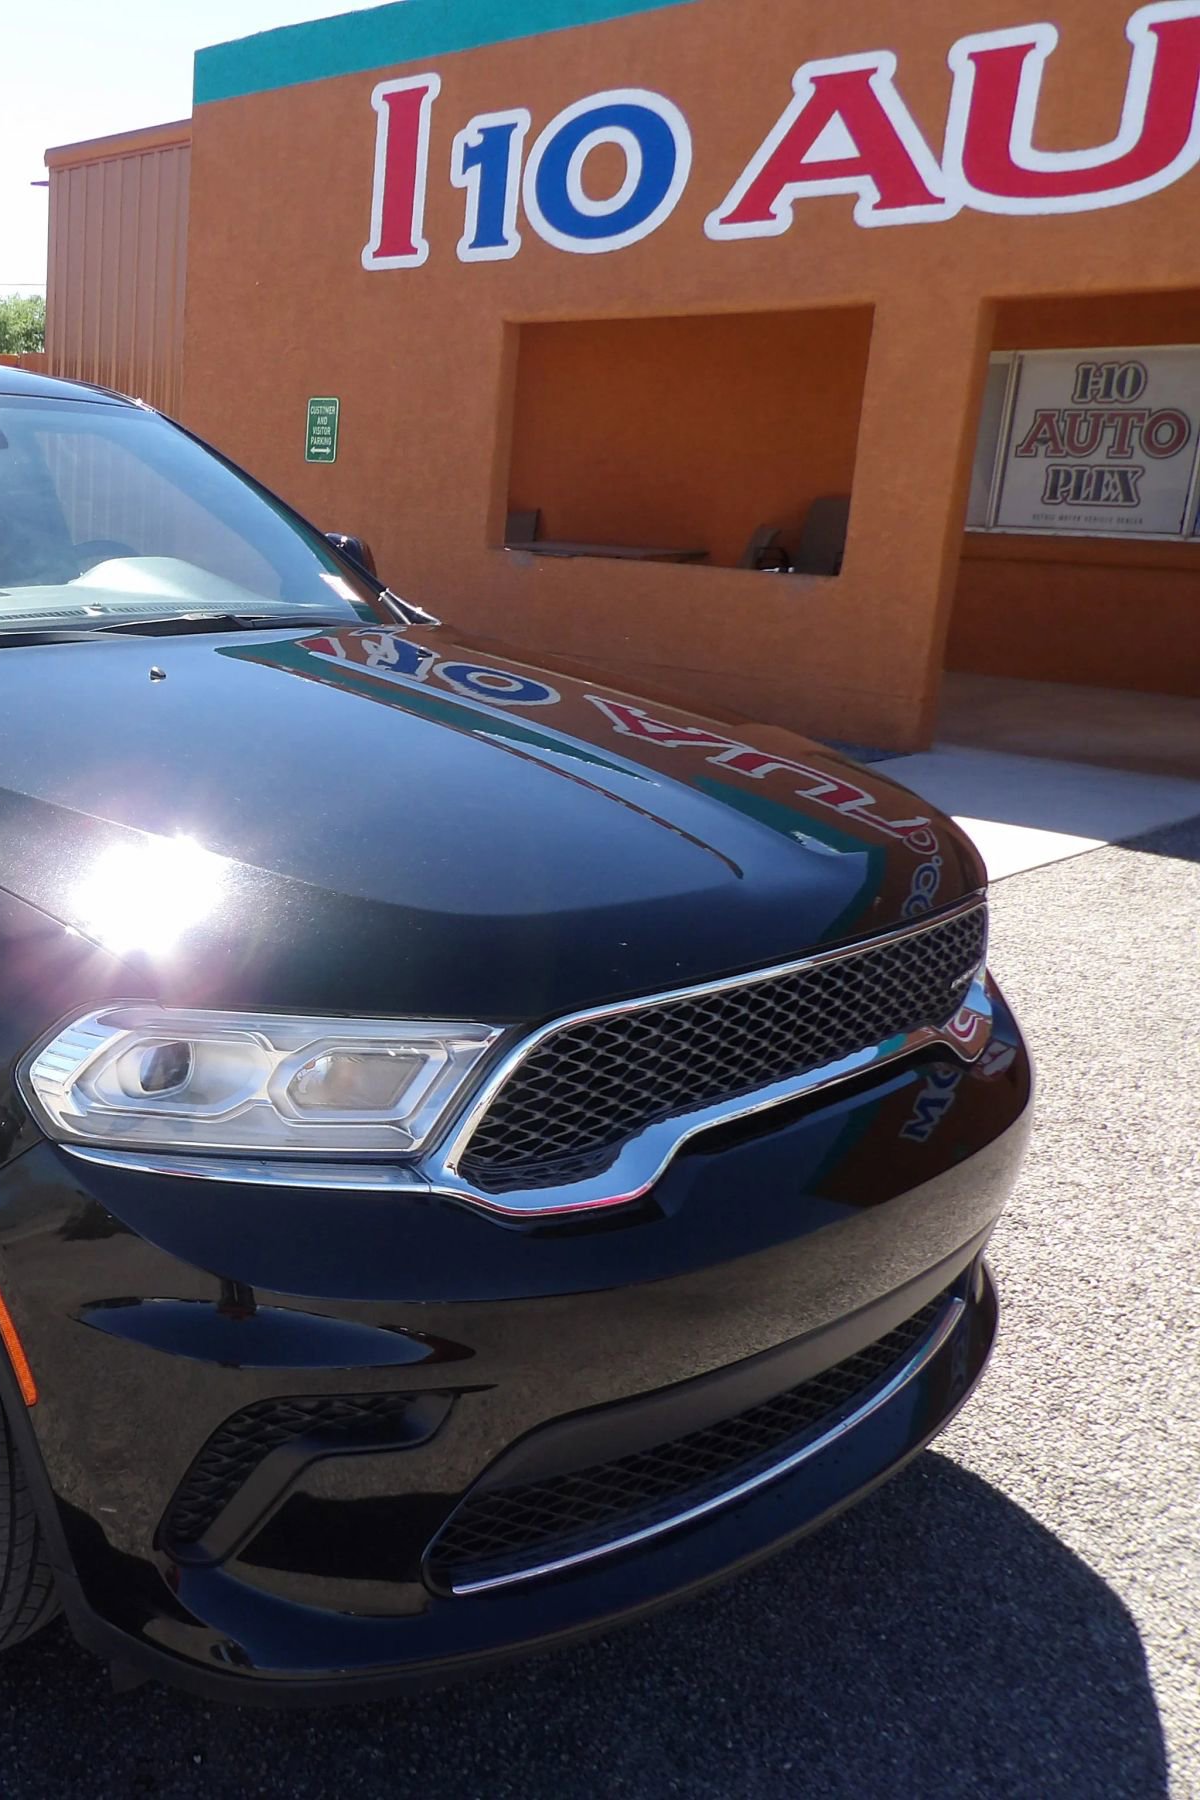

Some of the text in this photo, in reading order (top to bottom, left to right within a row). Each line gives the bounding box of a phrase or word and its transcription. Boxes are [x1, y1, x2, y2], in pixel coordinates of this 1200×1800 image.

[310, 406, 336, 415] CUSTOMER
[316, 416, 328, 425] AND
[312, 426, 331, 435] VISITOR
[1015, 408, 1192, 458] AUTO
[310, 436, 332, 445] PARKING
[1042, 464, 1145, 508] PLEX
